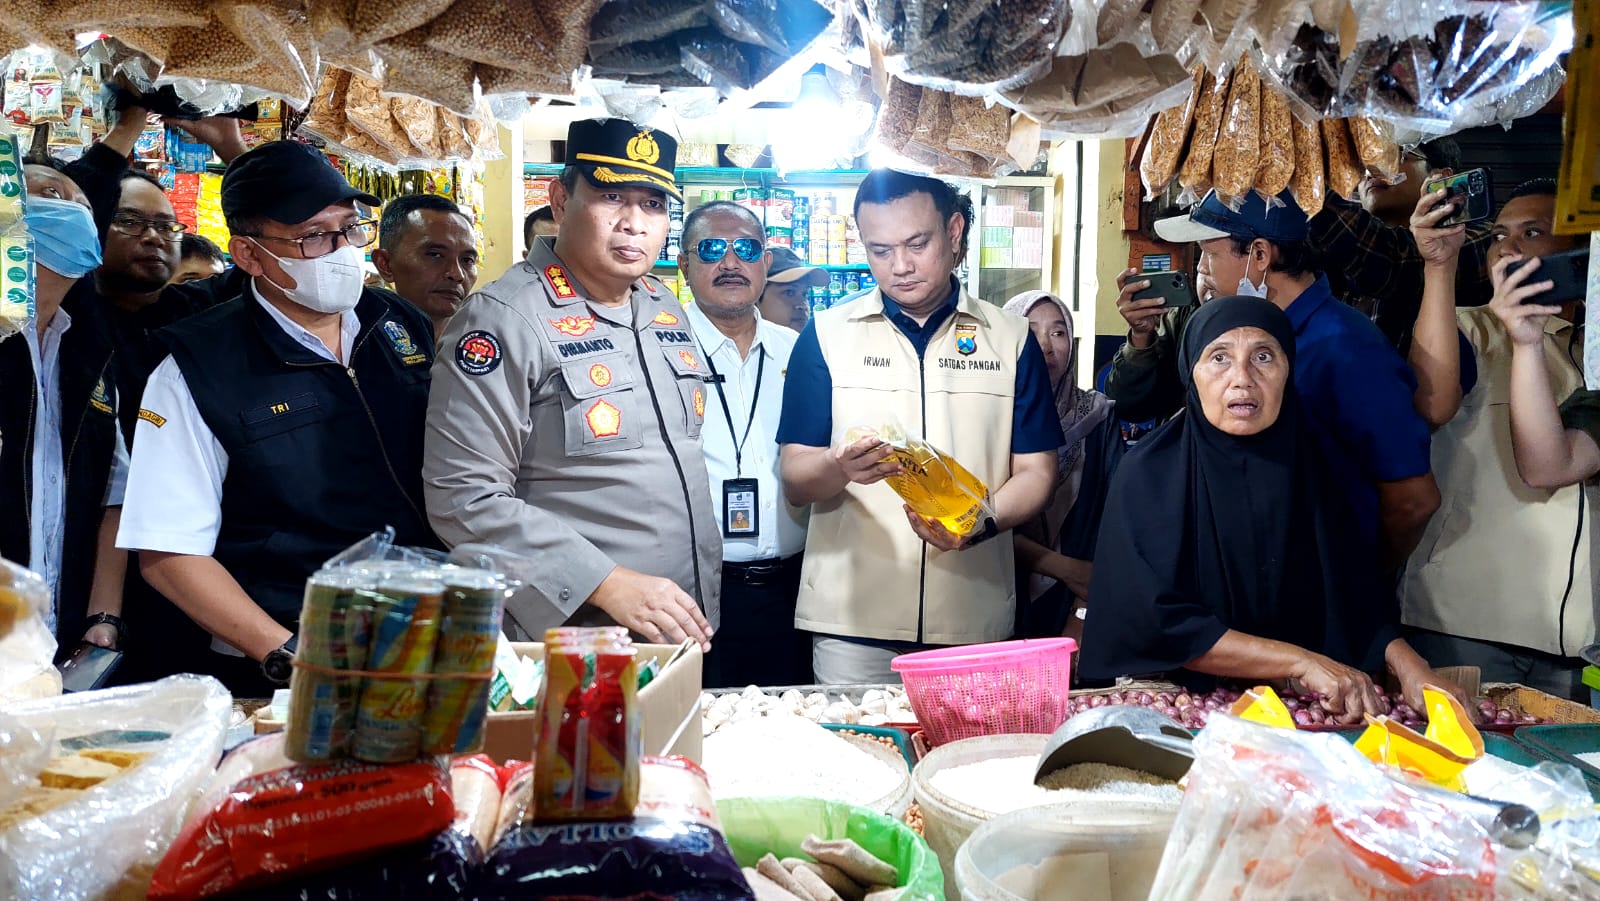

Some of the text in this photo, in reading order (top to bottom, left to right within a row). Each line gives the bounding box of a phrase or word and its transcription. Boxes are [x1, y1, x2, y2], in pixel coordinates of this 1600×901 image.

[655, 330, 692, 343] POLRI
[863, 356, 891, 368] IRWAN
[938, 358, 1001, 371] SATGAS PANGAN
[270, 402, 290, 414] TRI
